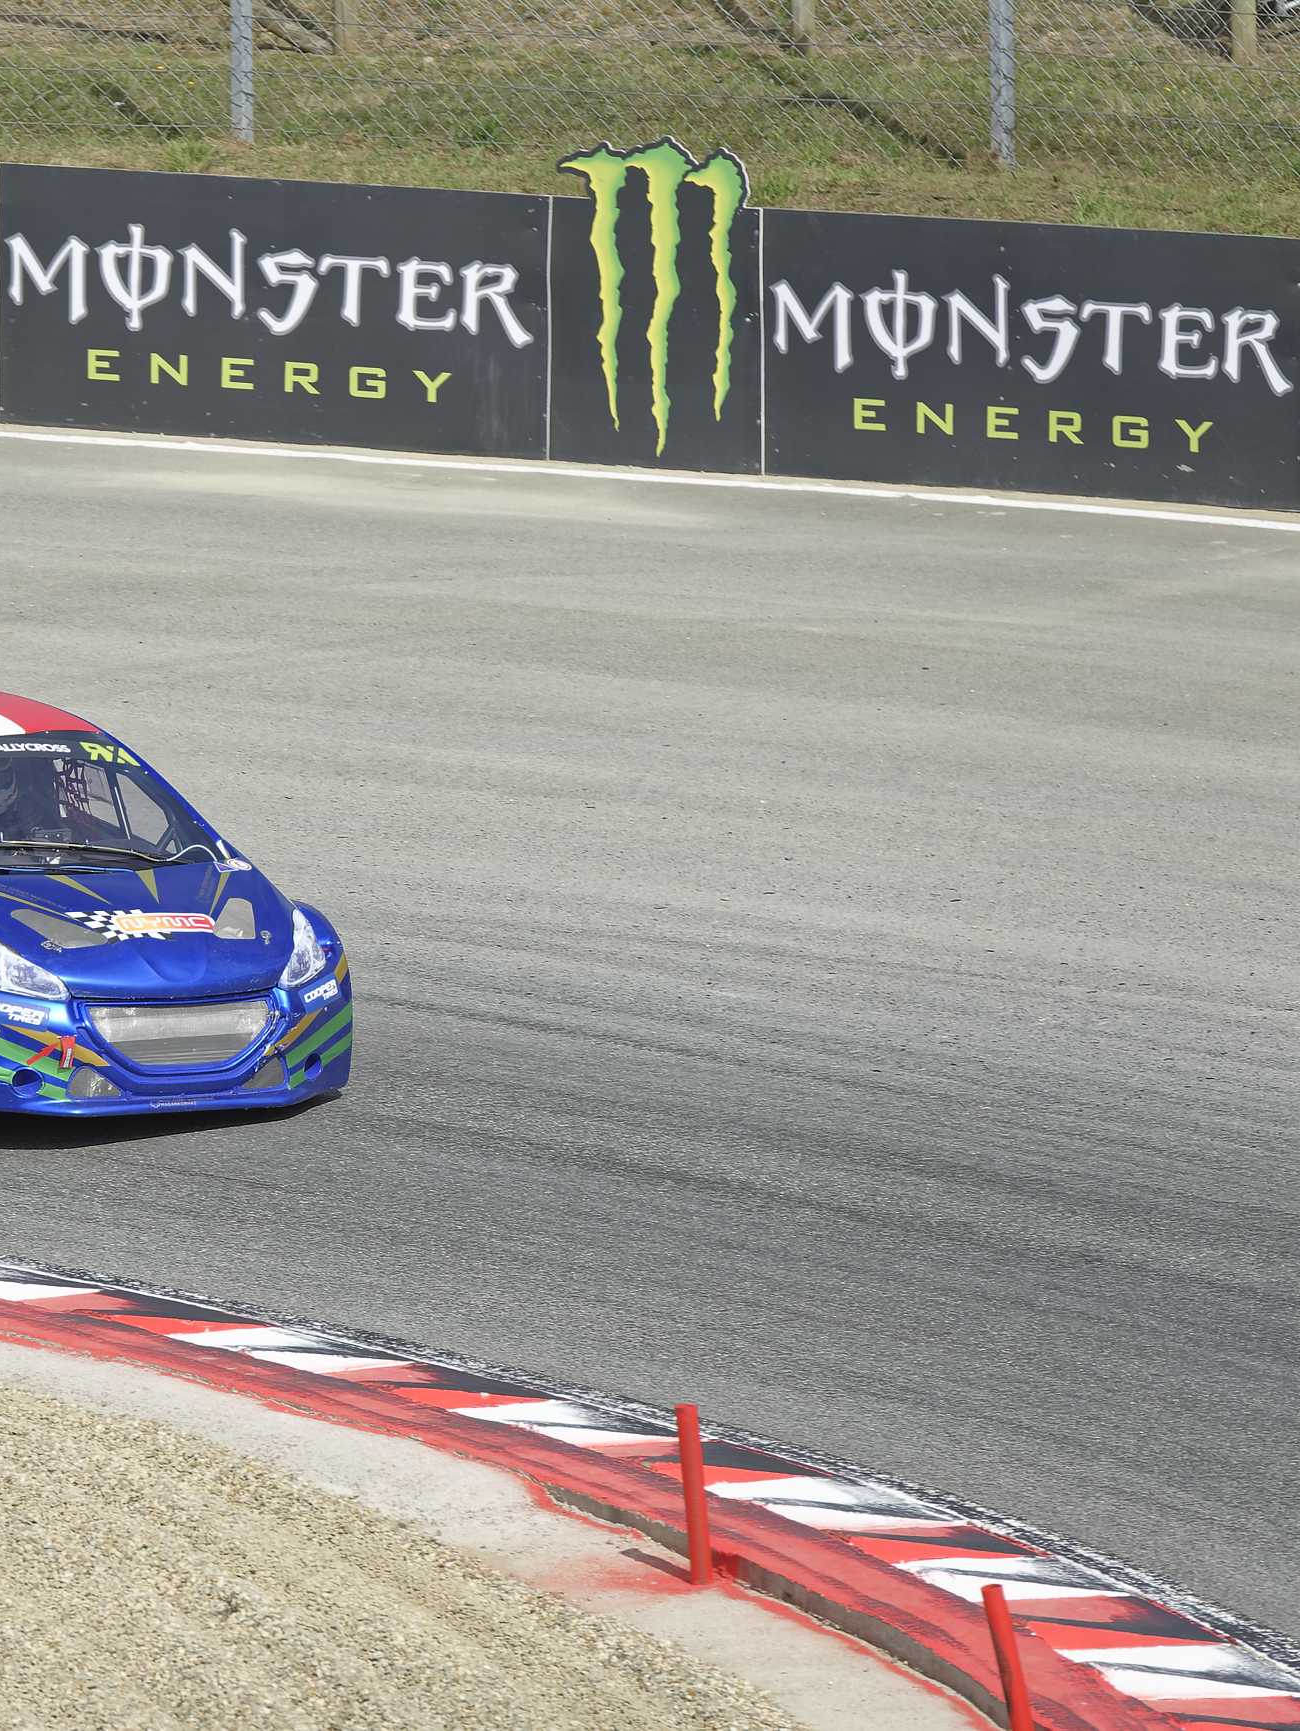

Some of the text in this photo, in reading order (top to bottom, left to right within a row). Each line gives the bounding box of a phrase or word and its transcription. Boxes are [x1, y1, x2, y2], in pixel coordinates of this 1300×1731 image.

[4, 223, 534, 348] MONSTER
[86, 348, 453, 403] ENERGY
[769, 269, 1295, 396] MONSTER
[853, 398, 1214, 453] ENERGY
